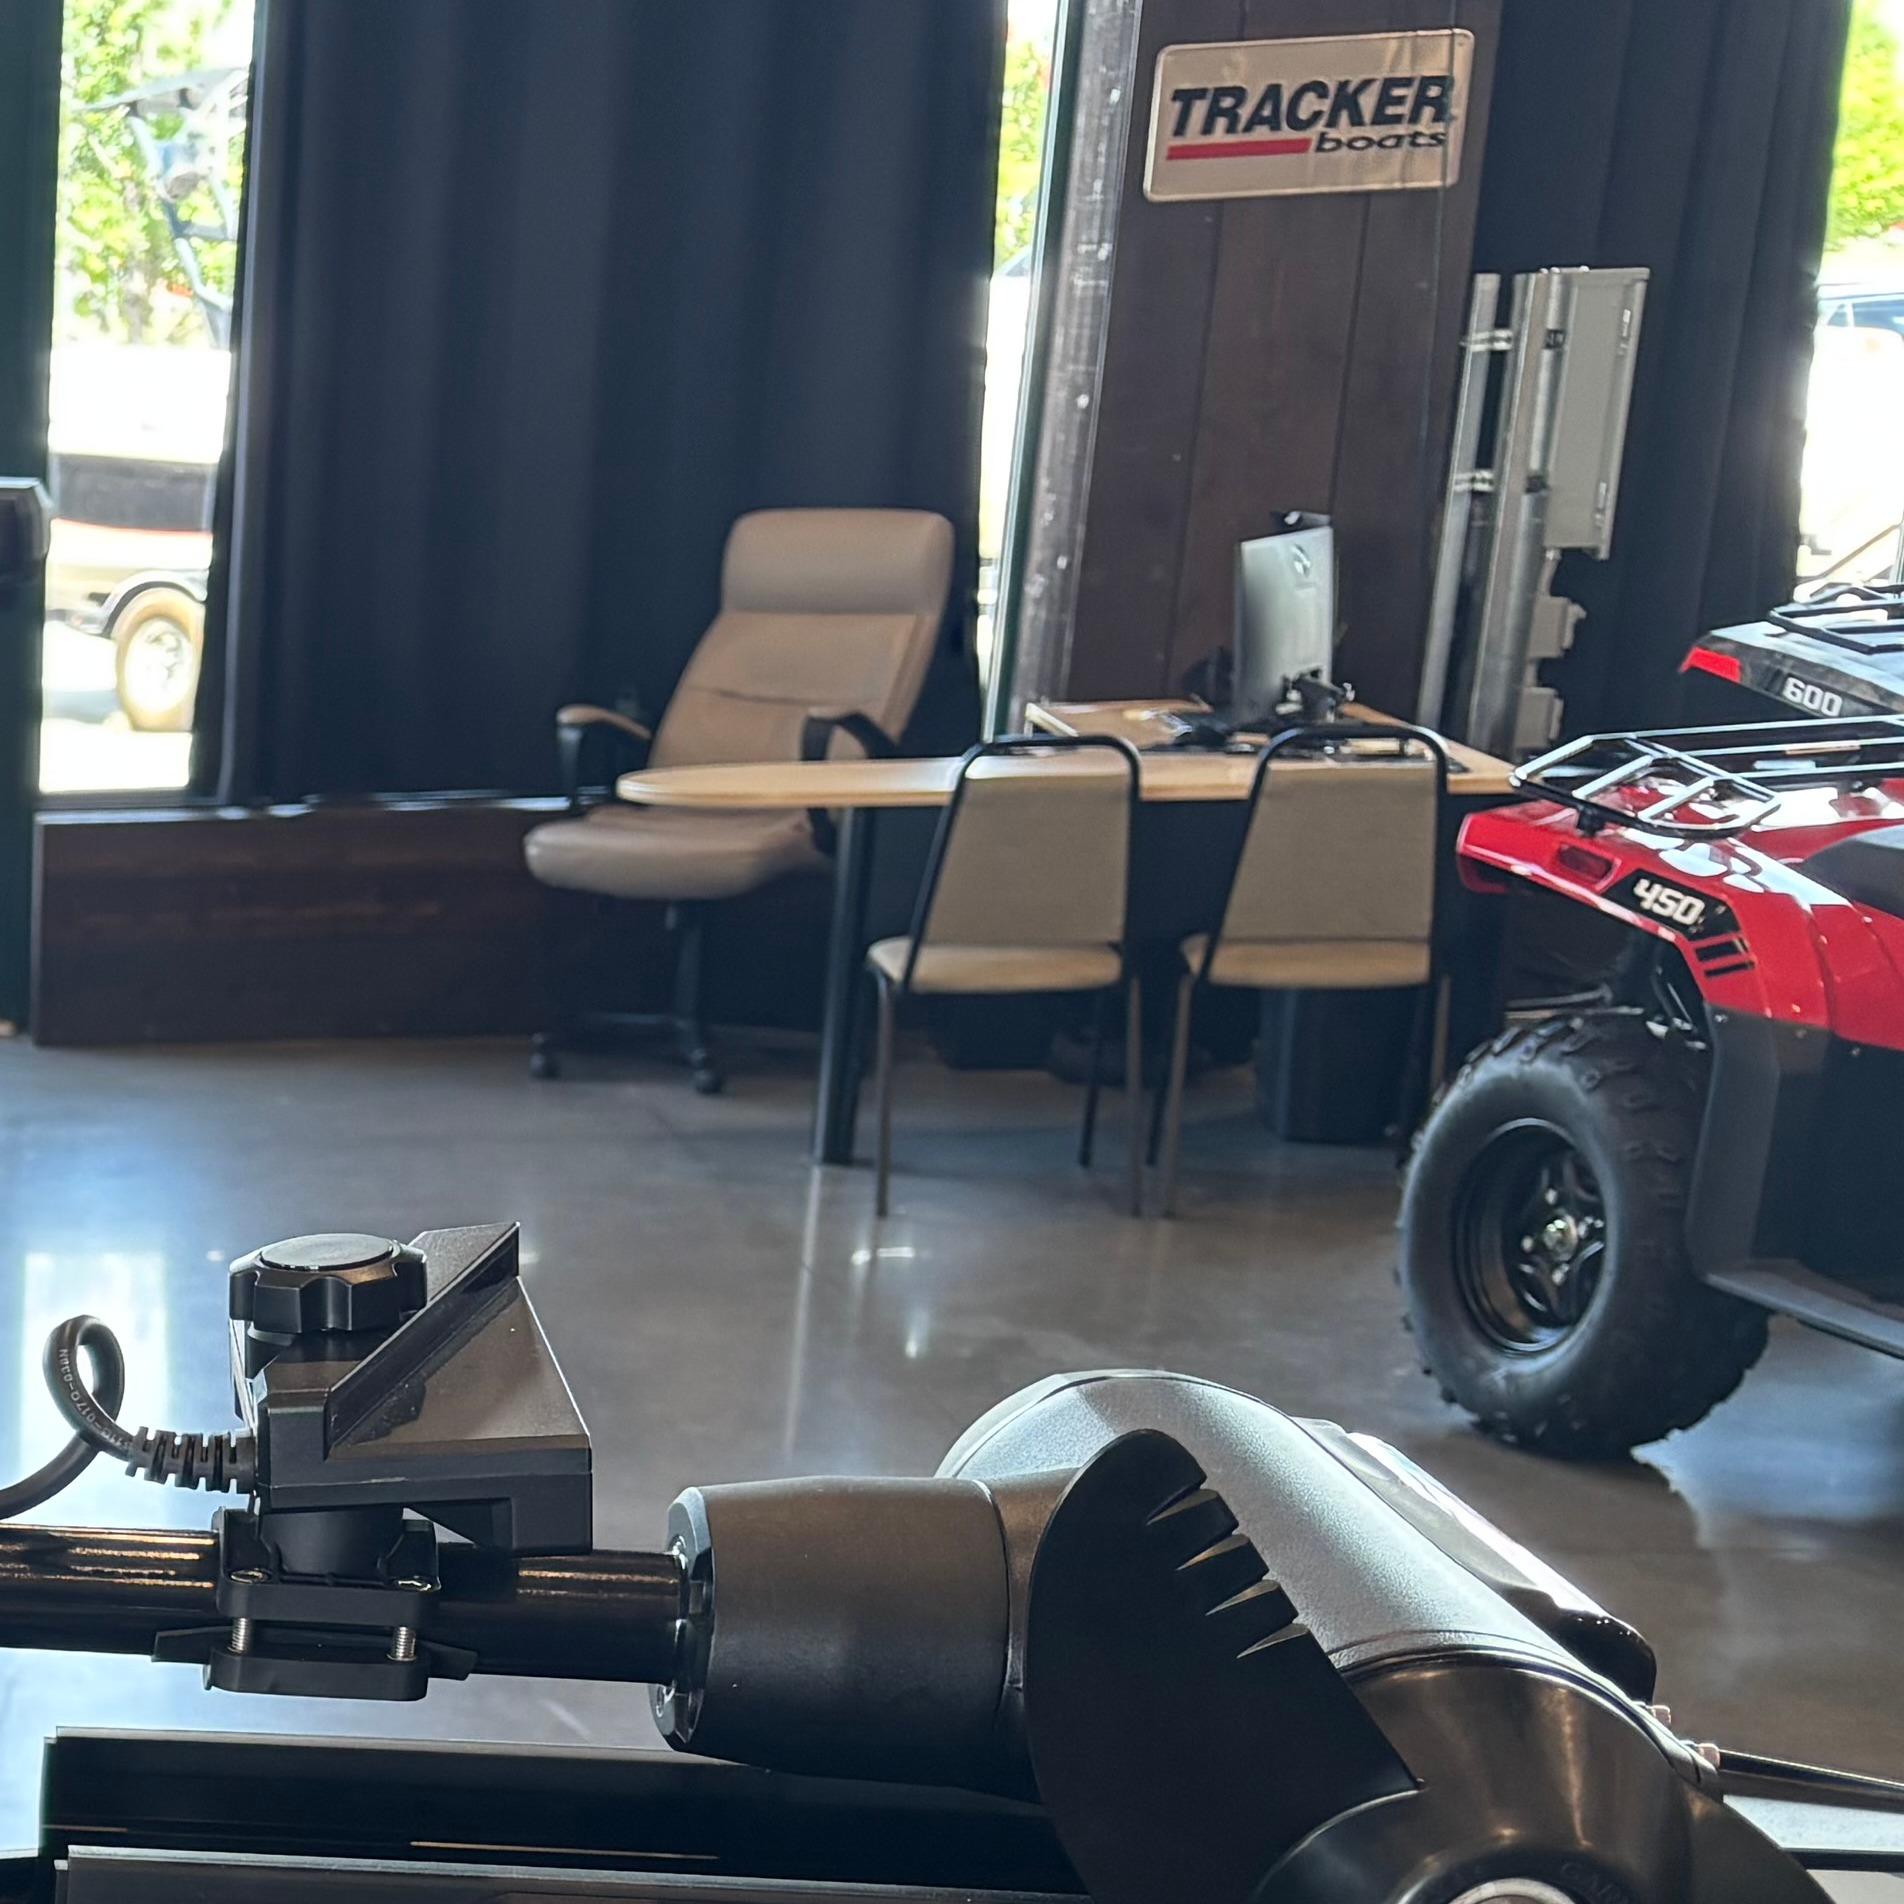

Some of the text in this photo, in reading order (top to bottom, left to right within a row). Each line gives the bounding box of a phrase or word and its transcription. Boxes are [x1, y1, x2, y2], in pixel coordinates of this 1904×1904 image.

[1170, 74, 1455, 137] TRACKER
[1315, 131, 1447, 153] boats
[1782, 677, 1843, 718] 600
[1632, 878, 1705, 926] 450
